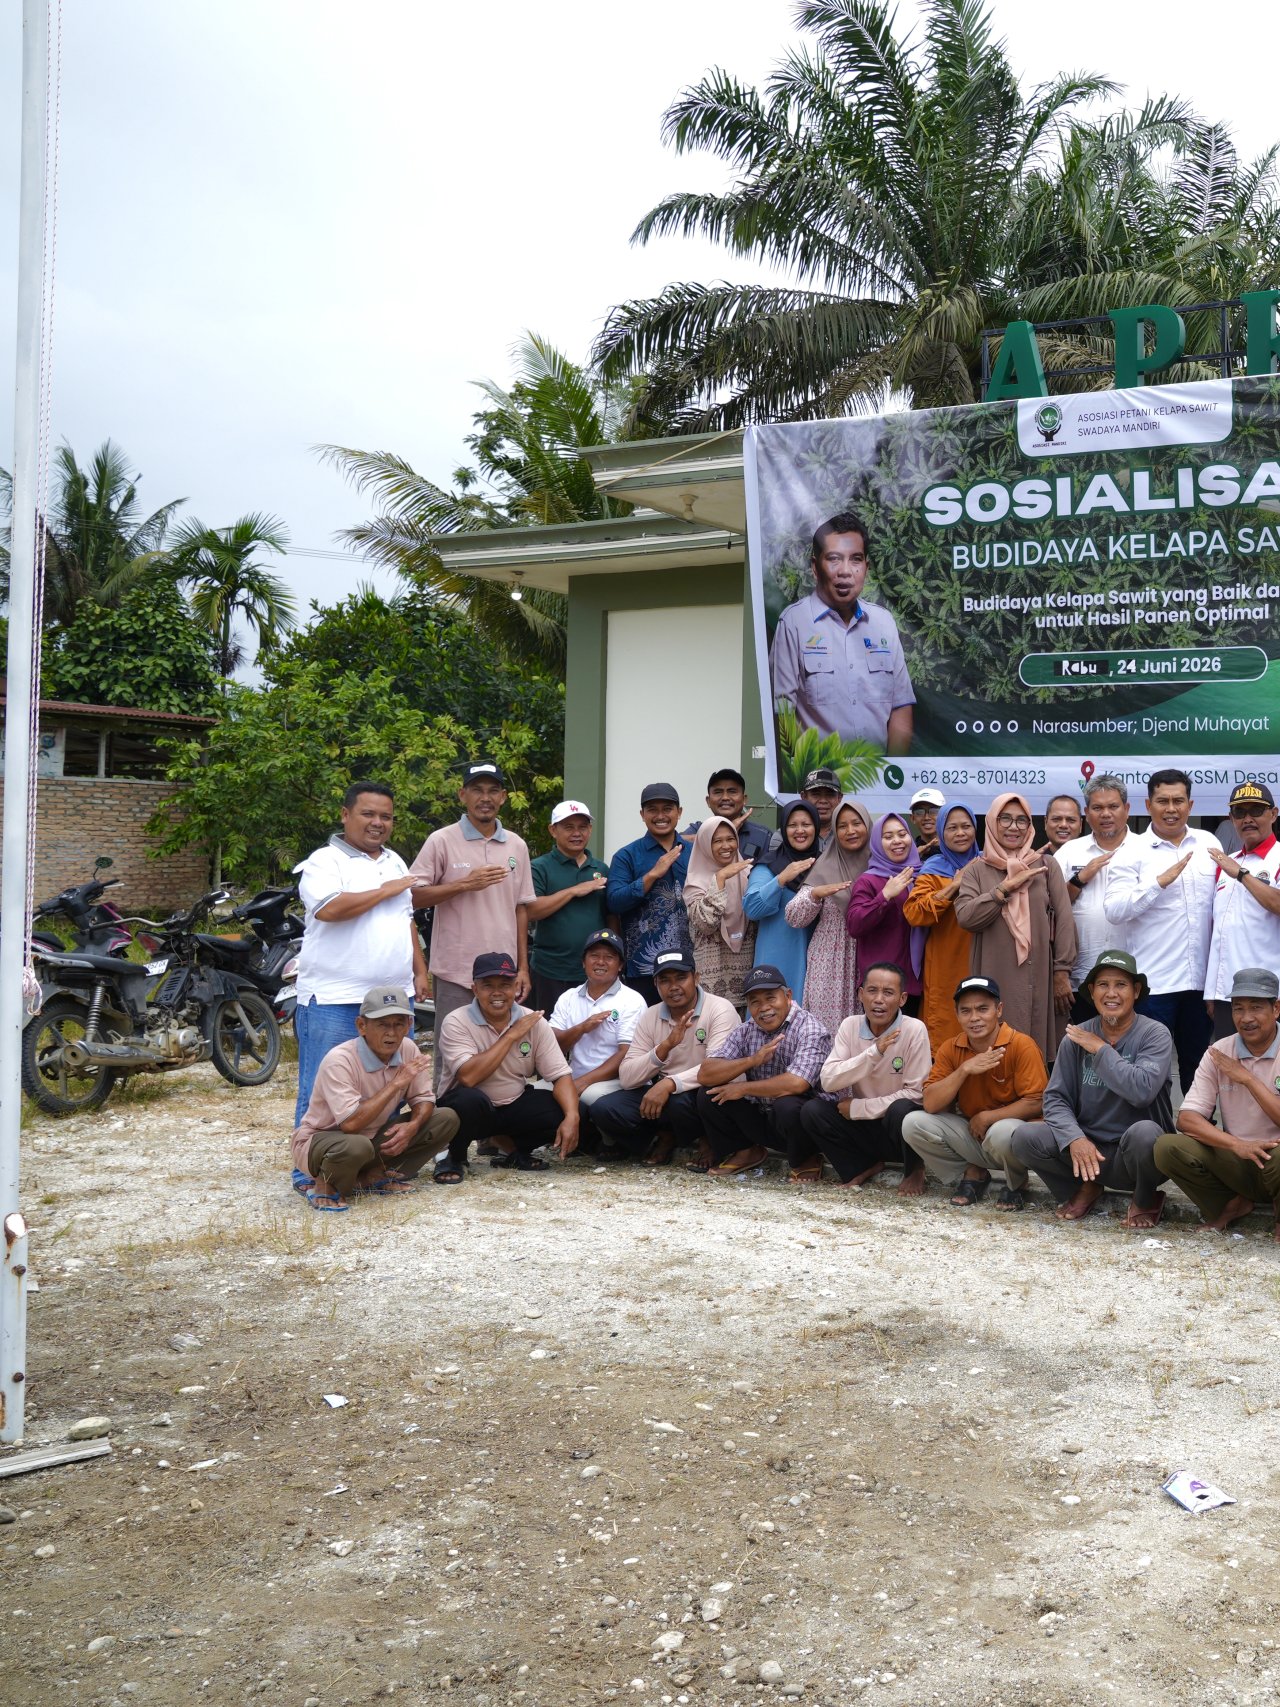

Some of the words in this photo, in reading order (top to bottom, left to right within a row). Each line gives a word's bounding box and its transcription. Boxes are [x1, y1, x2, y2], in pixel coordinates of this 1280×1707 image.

[1077, 411, 1119, 423] ASOSIASI
[1120, 408, 1151, 418] PETANI
[1153, 405, 1188, 416] KELAPA
[1189, 402, 1219, 413] SAWIT
[1077, 426, 1121, 437] SWADAYA
[1123, 421, 1161, 433] MANDIRI
[952, 536, 1100, 571] BUDIDAYA
[1108, 529, 1231, 562] KELAPA
[963, 593, 1042, 614] Budidaya
[1045, 591, 1105, 610] Kelapa
[1108, 587, 1158, 606] Sawit
[1160, 588, 1208, 607] yang
[1211, 584, 1251, 602] Baik
[1035, 611, 1084, 628] untuk
[1088, 608, 1131, 626] Hasil
[1134, 606, 1191, 624] Panen
[1194, 603, 1270, 625] Optimal
[1062, 660, 1097, 676] Rabu
[1117, 658, 1137, 675] 24
[1140, 657, 1178, 674] Juni
[1180, 656, 1222, 673] 2026
[1032, 718, 1138, 735] Narasumber;
[1141, 717, 1190, 736] Djend
[1194, 715, 1270, 735] Muhayat
[911, 770, 938, 784] +62
[942, 769, 1046, 785] 823-87014323
[1235, 769, 1278, 783] Desa
[1233, 786, 1263, 800] APDESI
